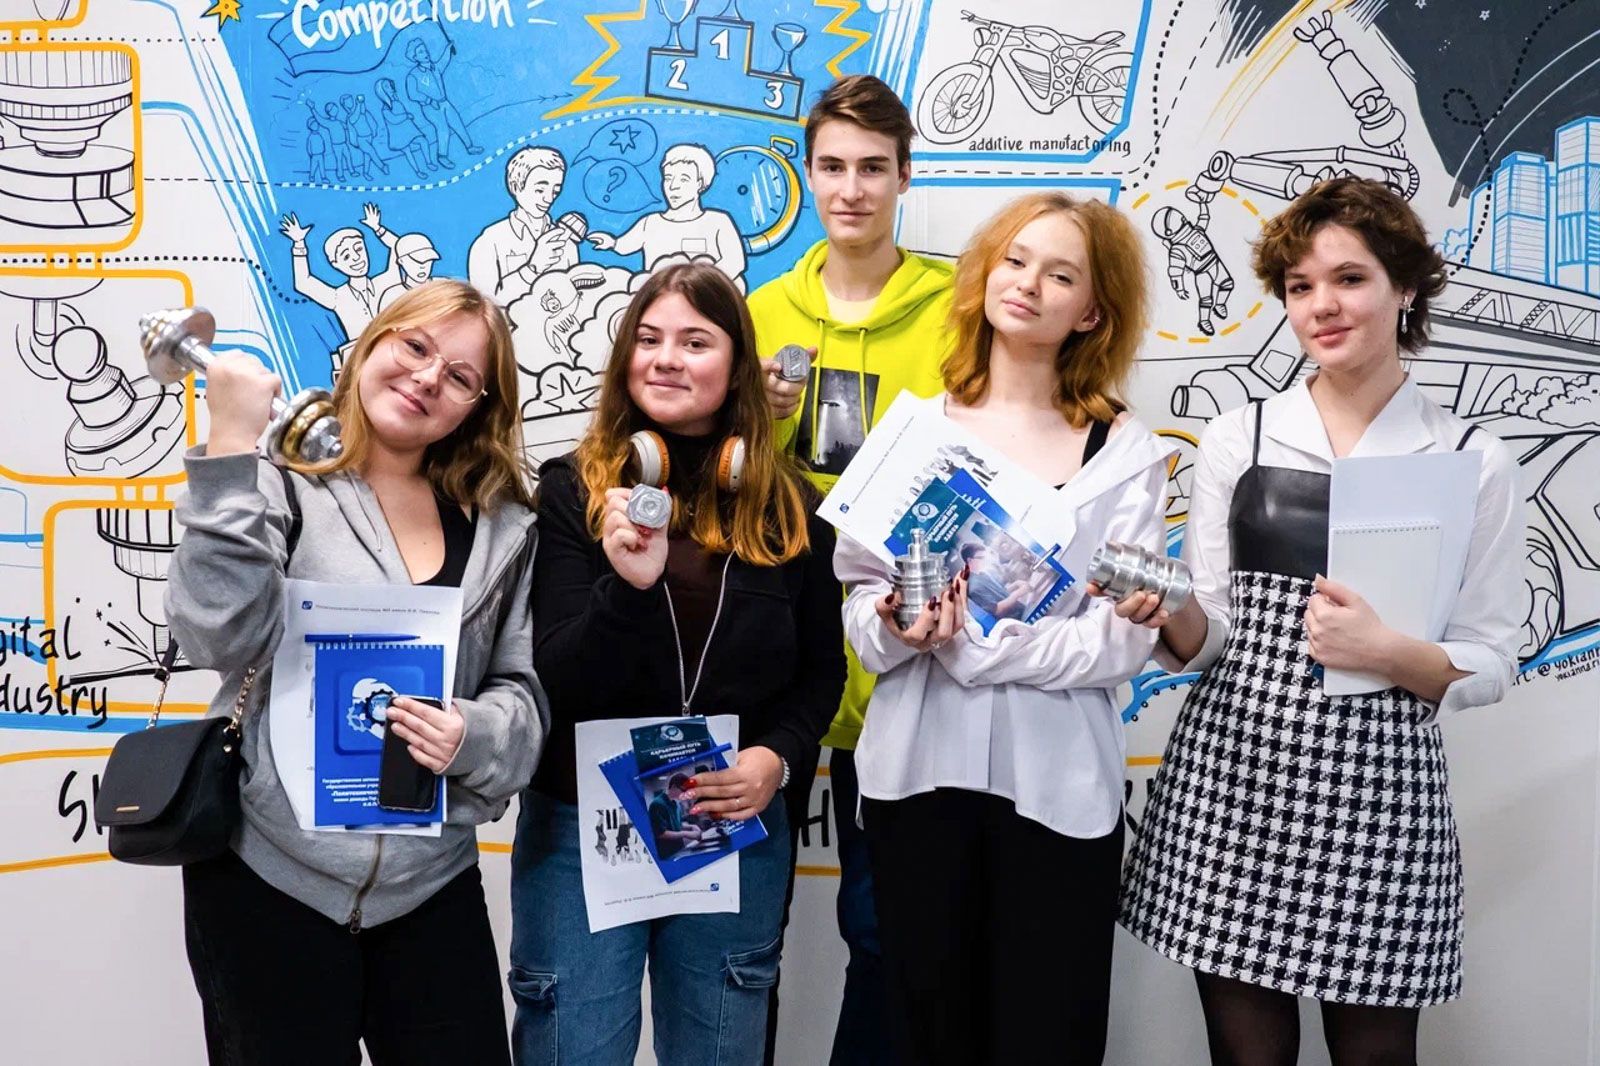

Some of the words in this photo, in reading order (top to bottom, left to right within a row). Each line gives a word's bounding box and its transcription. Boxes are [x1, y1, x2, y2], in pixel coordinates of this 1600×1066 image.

[292, 0, 514, 49] Competition
[710, 28, 730, 60] 1
[666, 59, 689, 91] 2
[764, 81, 784, 110] 3
[968, 136, 1024, 151] additive
[1029, 134, 1132, 158] manufactoring
